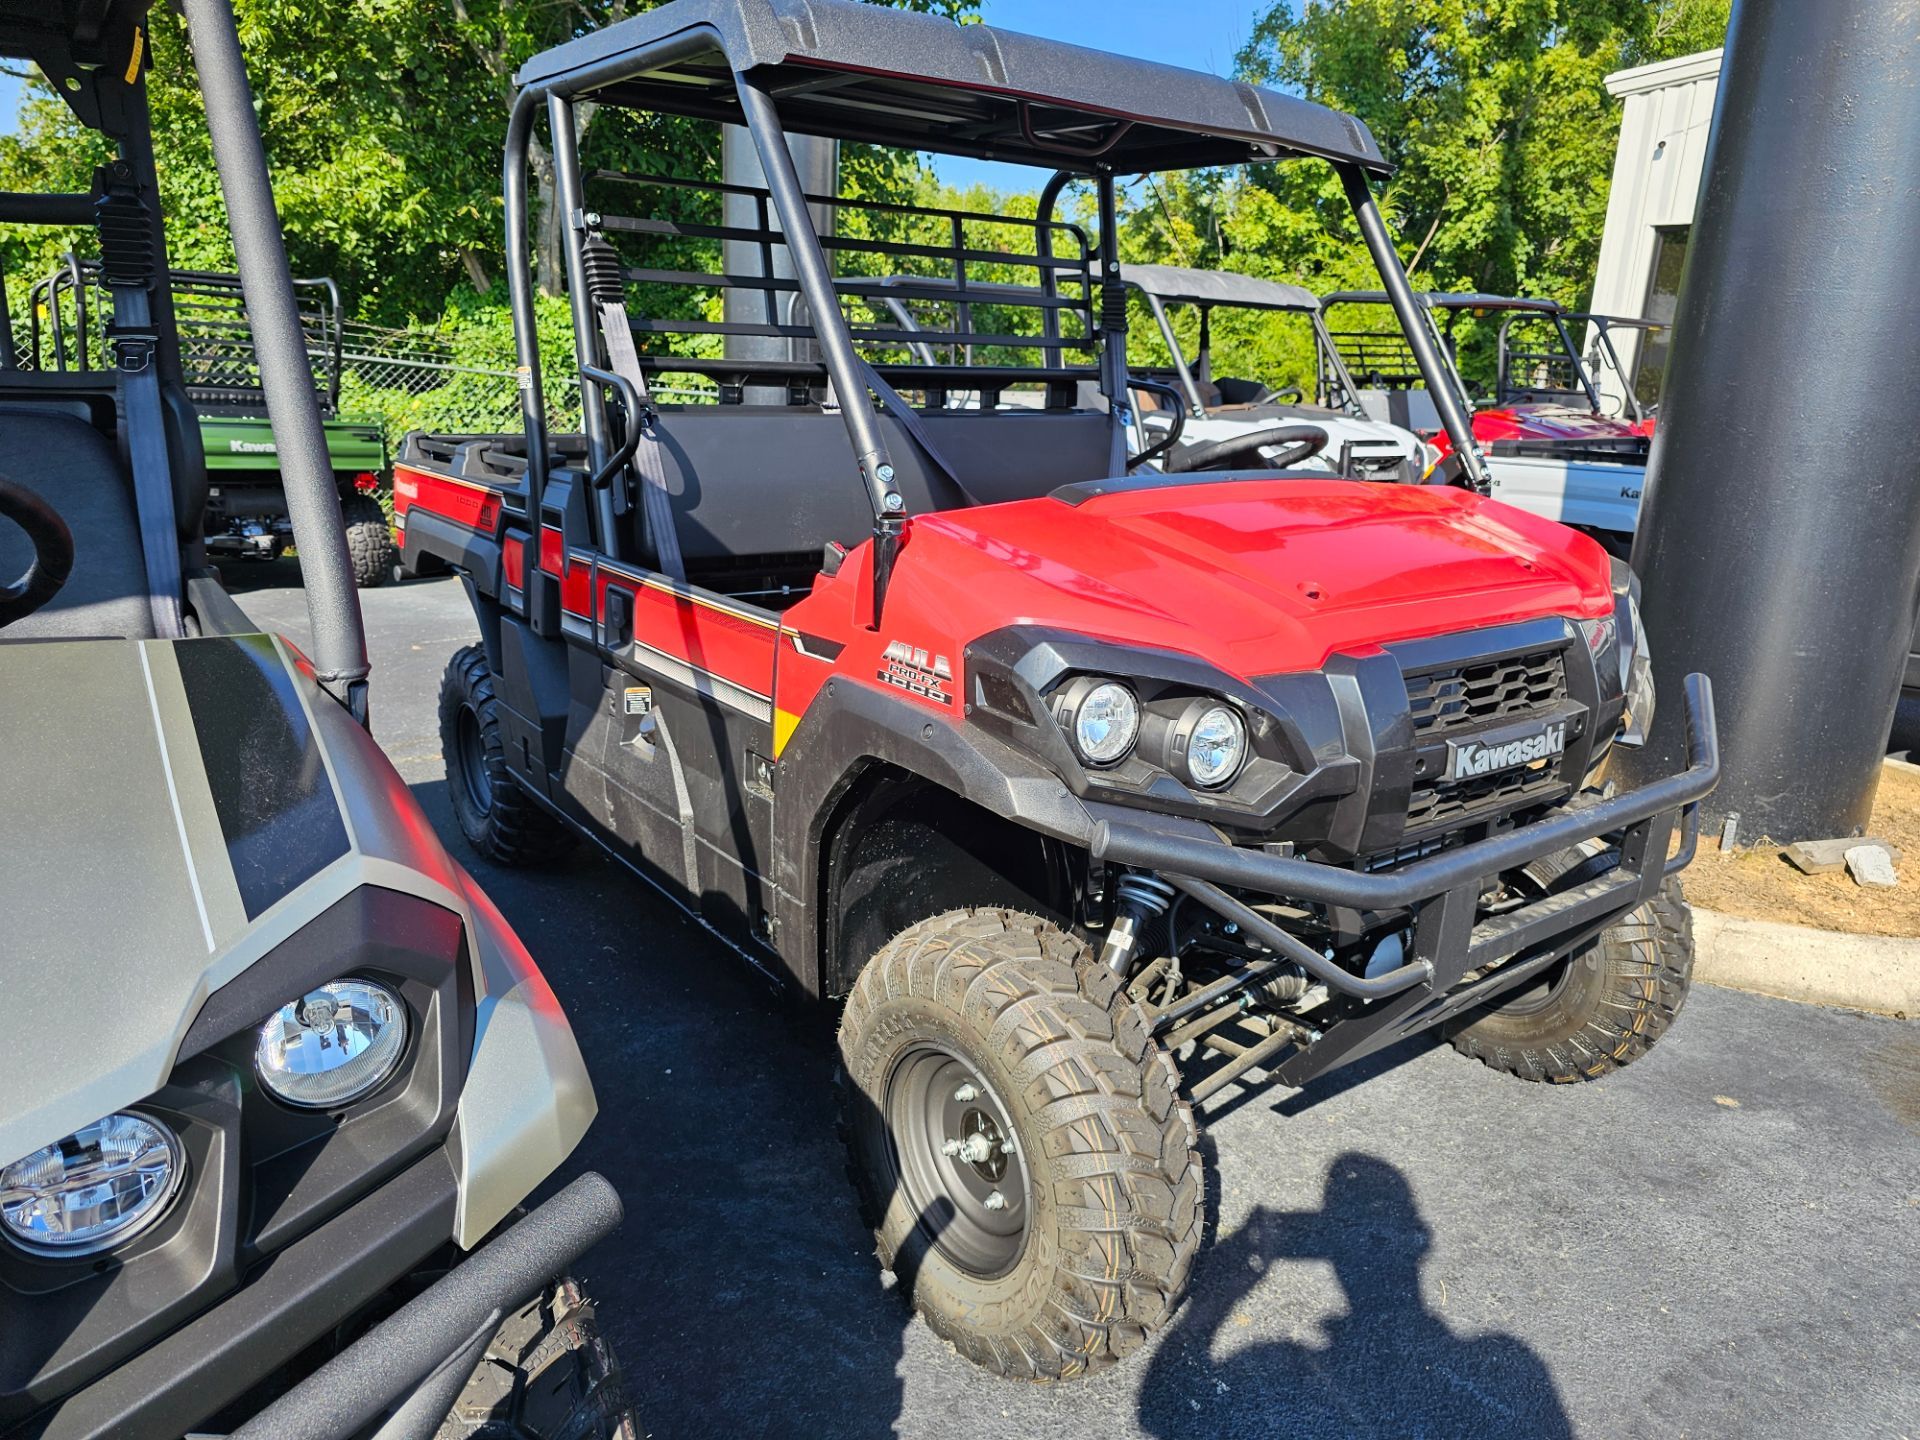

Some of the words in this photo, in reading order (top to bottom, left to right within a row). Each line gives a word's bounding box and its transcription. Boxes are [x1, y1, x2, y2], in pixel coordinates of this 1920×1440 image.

[230, 440, 277, 452] Kawa
[881, 640, 952, 682] MULE
[883, 672, 946, 702] 1000
[1455, 723, 1564, 779] Kawasaki
